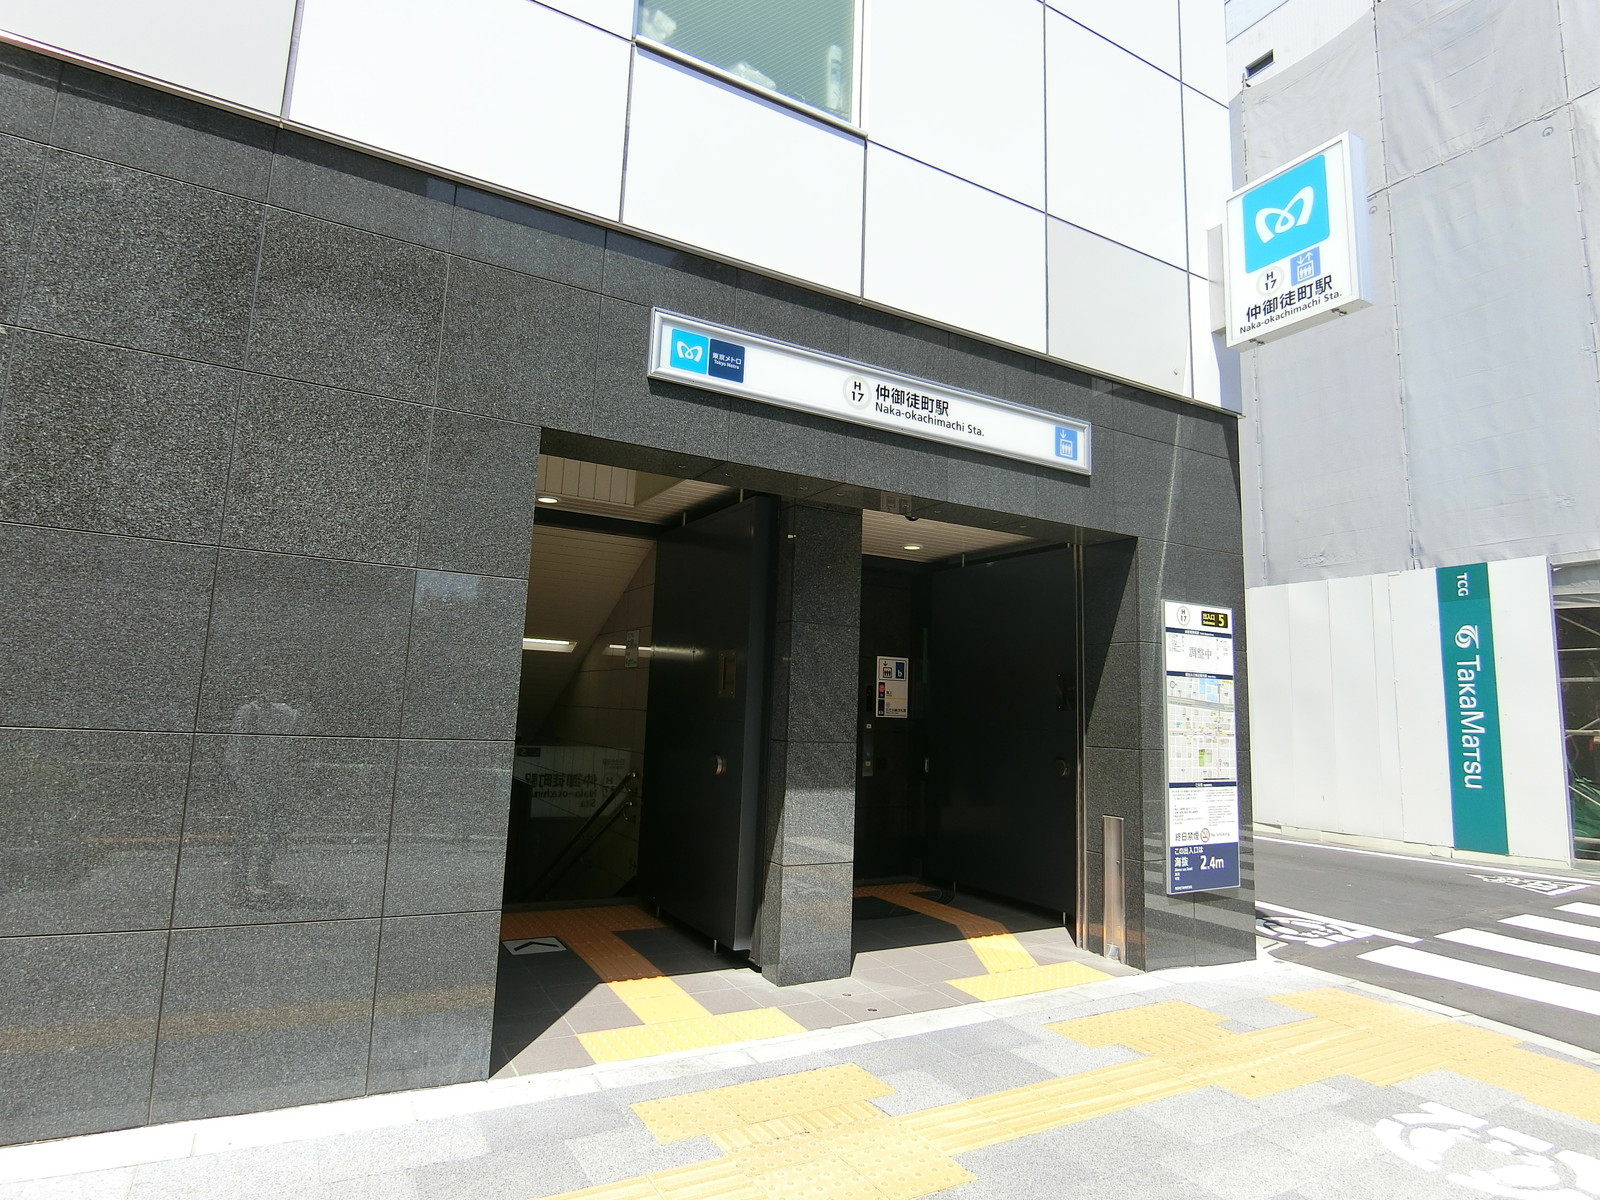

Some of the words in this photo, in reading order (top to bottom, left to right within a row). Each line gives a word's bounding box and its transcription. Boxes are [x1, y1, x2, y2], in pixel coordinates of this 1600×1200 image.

[1266, 272, 1274, 281] H
[1264, 279, 1277, 291] 17
[1246, 274, 1333, 322] 仲御徒町駅
[1239, 297, 1321, 334] Naka-okachimachi
[1324, 289, 1343, 303] Sta.
[712, 352, 742, 365] 東京メトロ
[853, 381, 862, 391] H
[851, 391, 864, 402] 17
[876, 384, 949, 417] 仲御徒町駅
[875, 402, 965, 432] Naka-okachimachi
[967, 424, 985, 437] Sta.
[1456, 572, 1469, 597] TCG
[1218, 614, 1225, 627] 5
[1174, 846, 1204, 855] この出入口は
[1200, 855, 1225, 870] 2.4m
